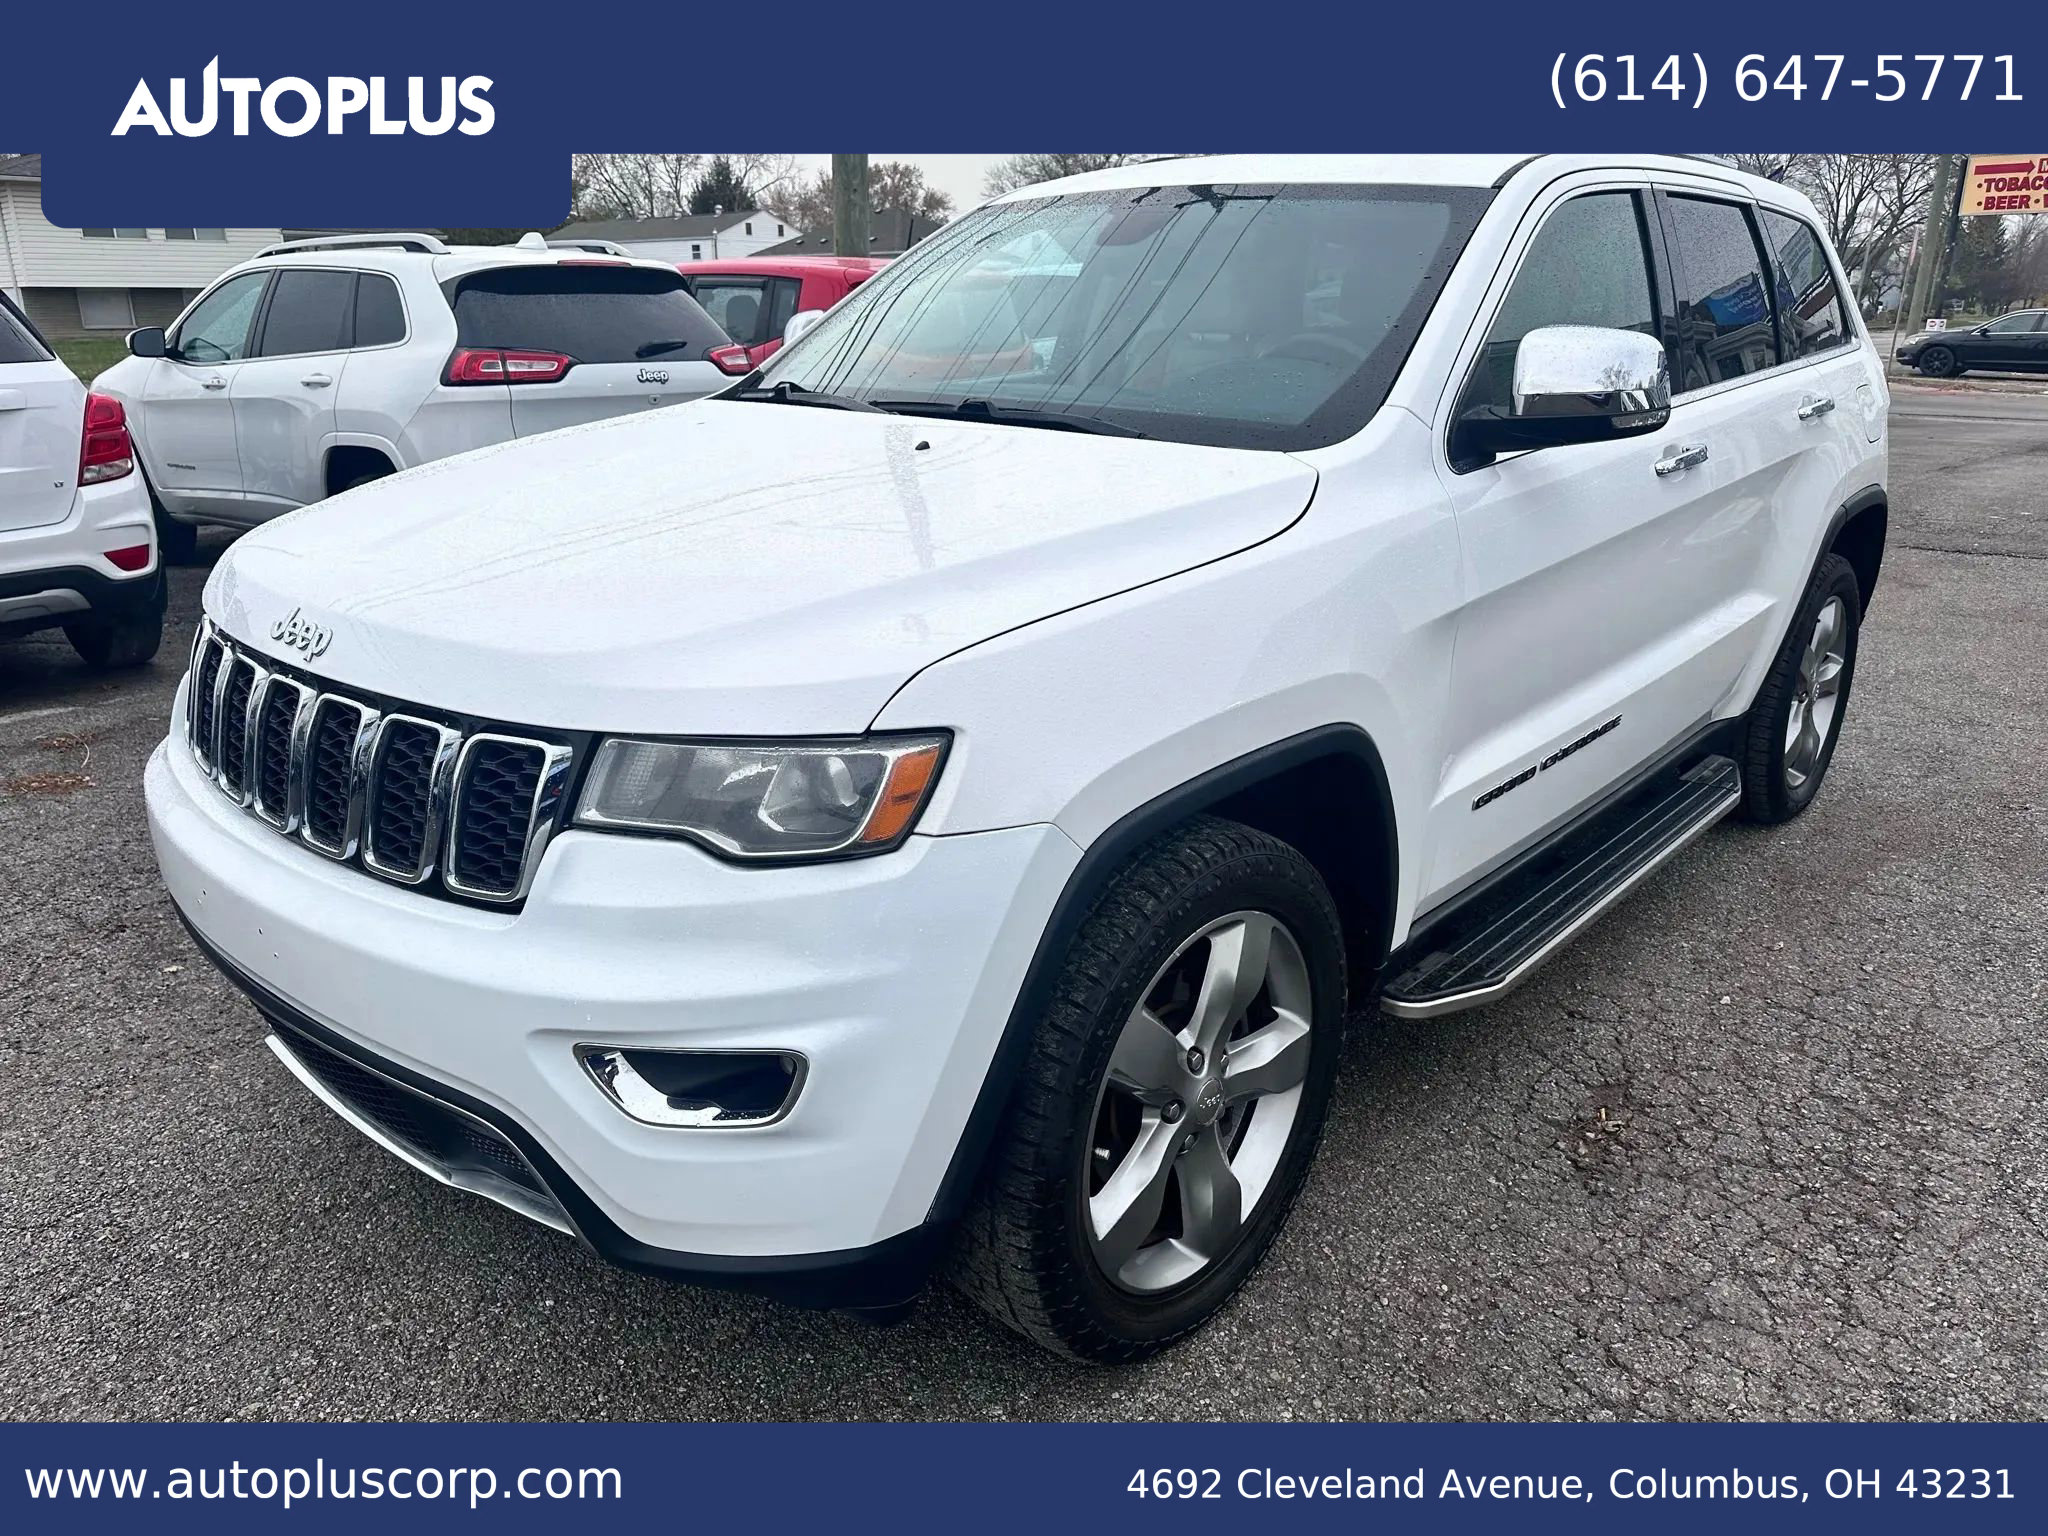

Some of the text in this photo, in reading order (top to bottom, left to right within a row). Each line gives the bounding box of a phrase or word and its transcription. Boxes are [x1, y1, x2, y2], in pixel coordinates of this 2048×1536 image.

[1983, 194, 2031, 211] BEER
[637, 368, 669, 385] Jeep
[270, 607, 333, 663] Jeep
[1472, 764, 1537, 811] GRAND
